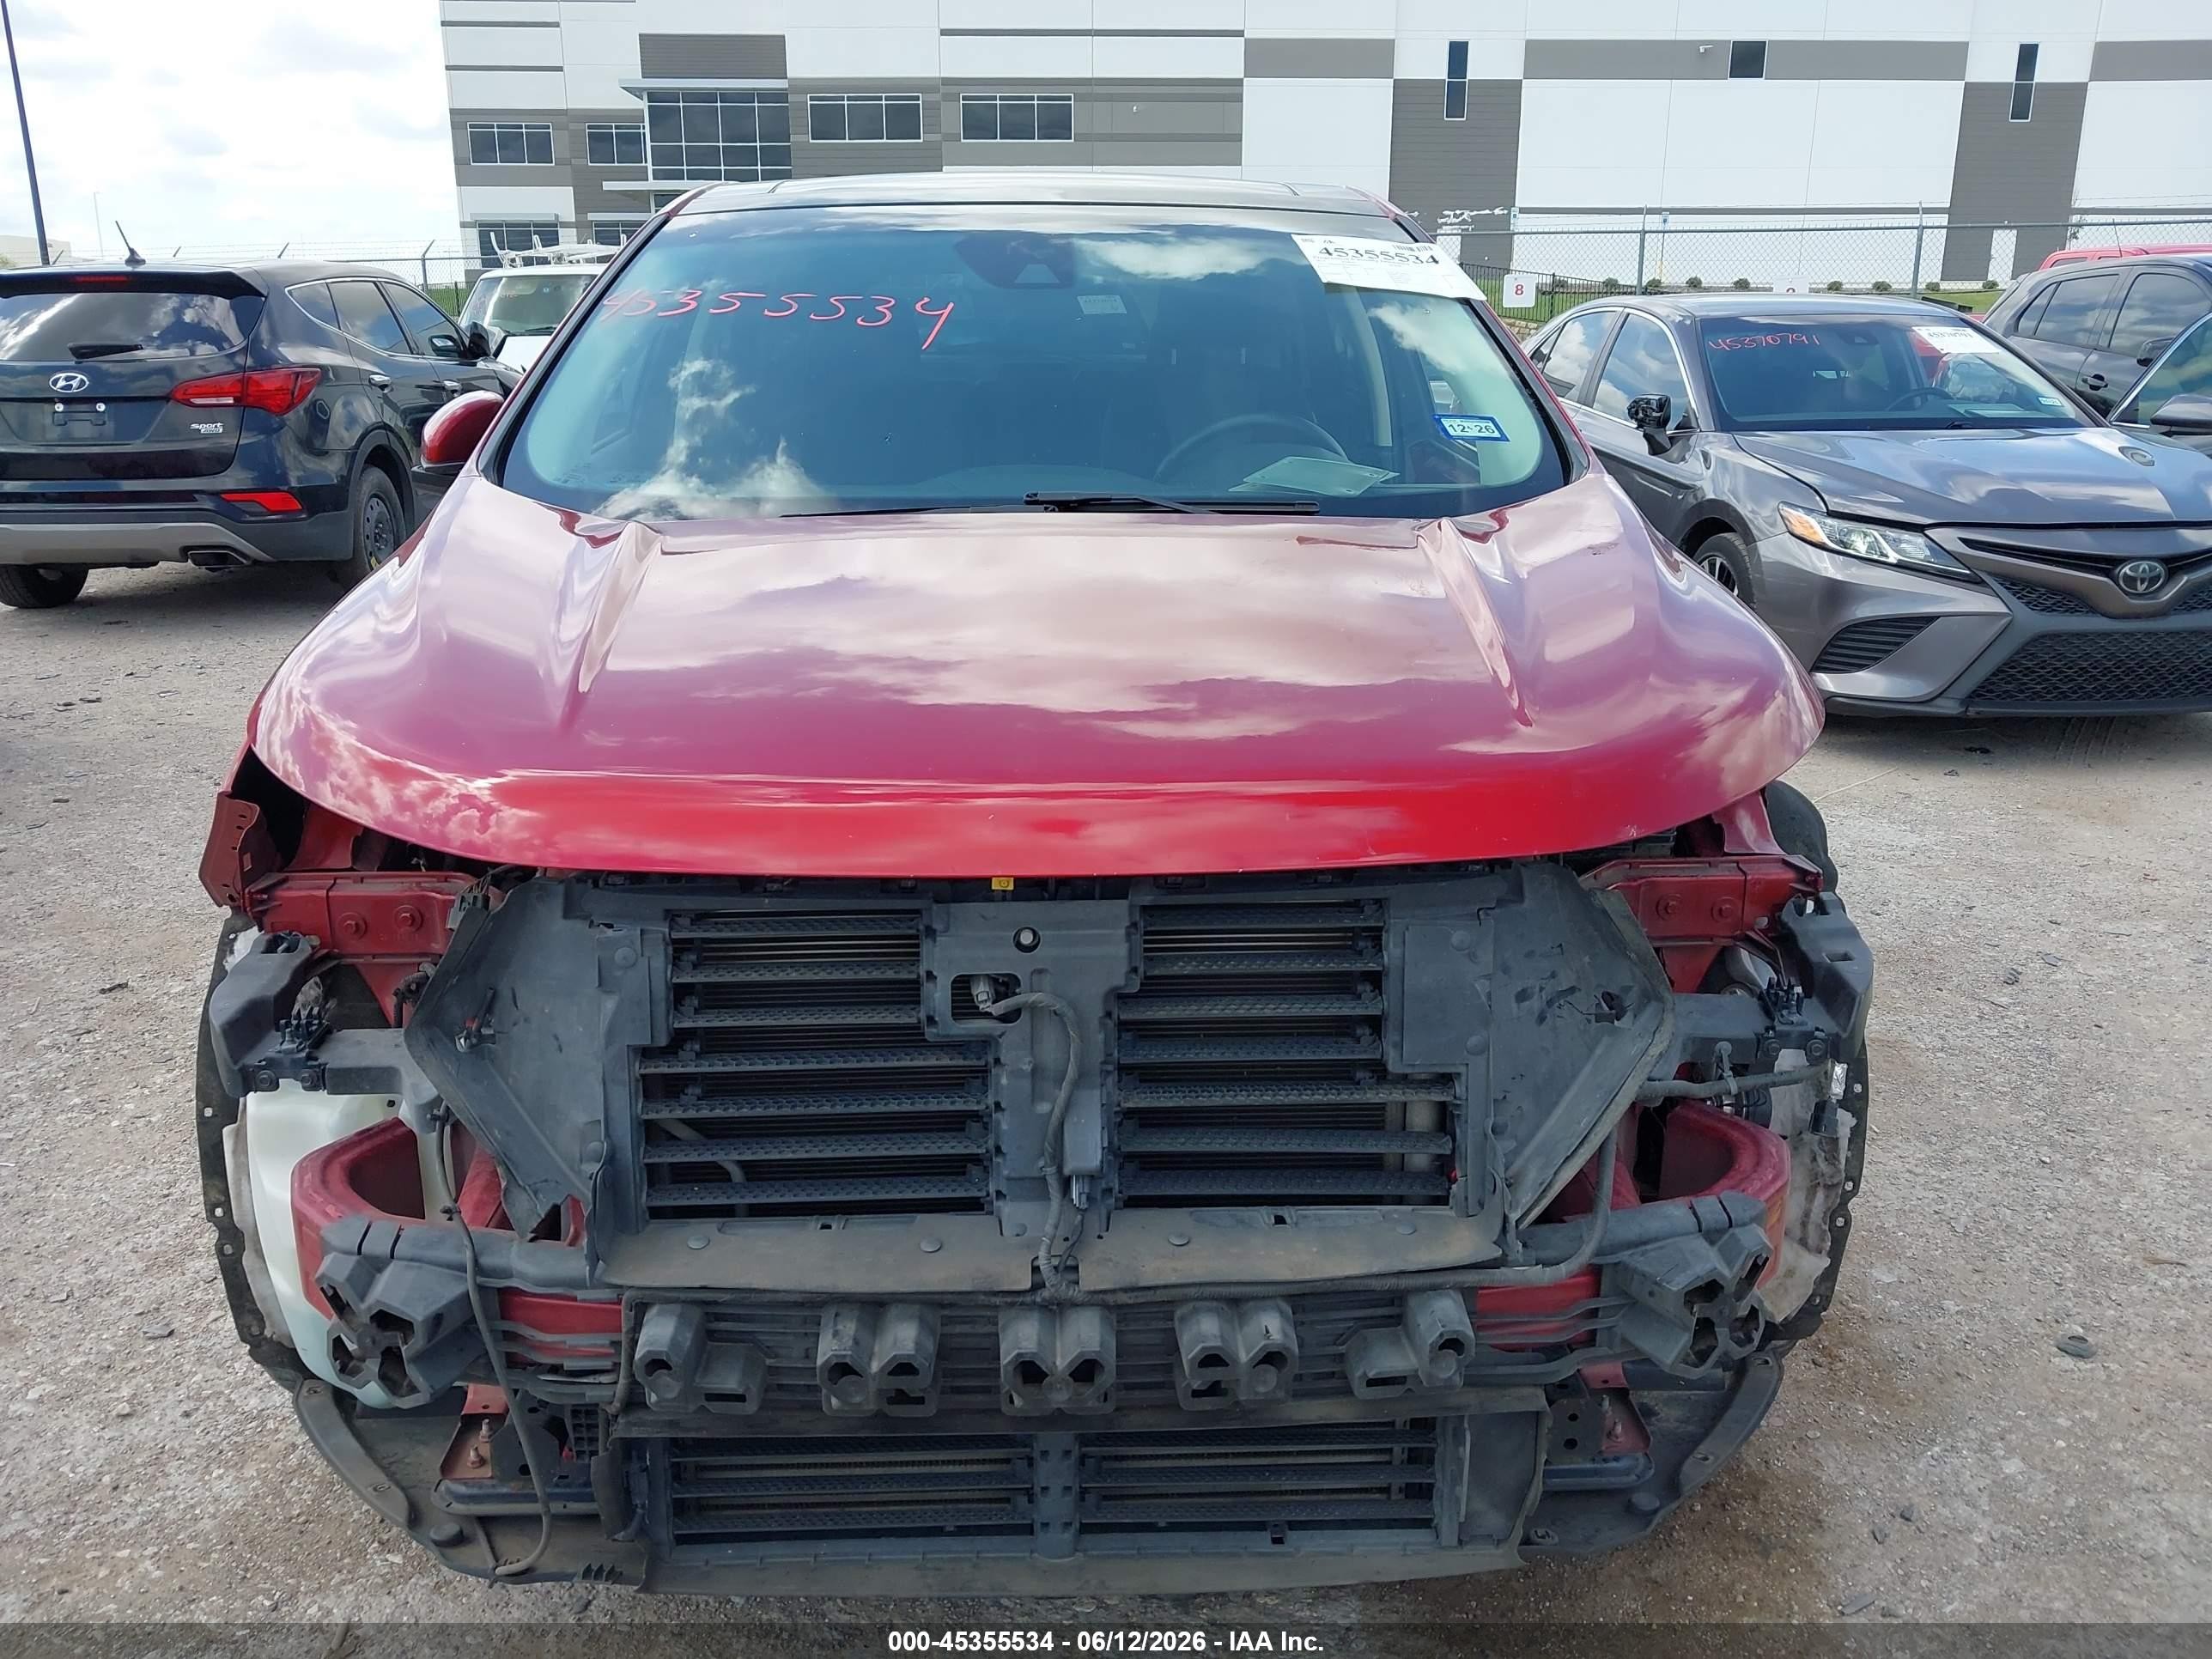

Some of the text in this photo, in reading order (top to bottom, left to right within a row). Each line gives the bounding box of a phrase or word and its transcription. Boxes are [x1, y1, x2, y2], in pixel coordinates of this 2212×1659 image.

[1318, 246, 1439, 264] 45355534
[1514, 283, 1524, 296] 8
[599, 289, 955, 350] 45355534
[1708, 332, 1820, 351] 45370791
[1448, 424, 1495, 434] 12 26
